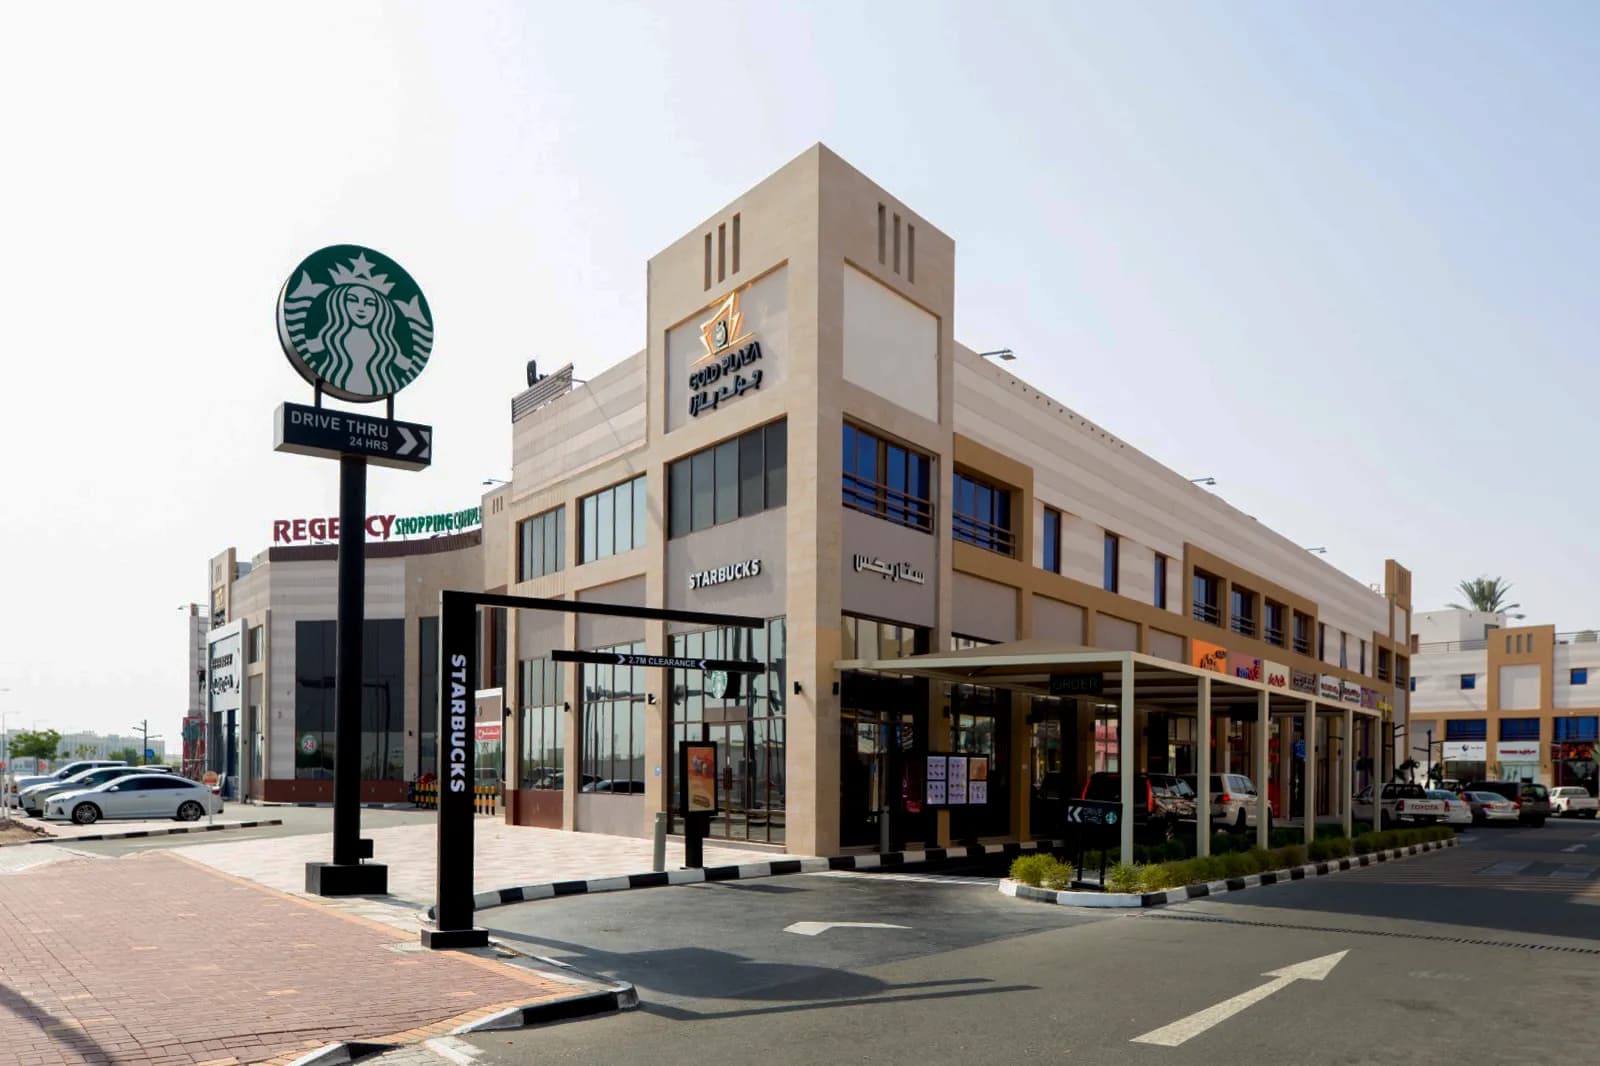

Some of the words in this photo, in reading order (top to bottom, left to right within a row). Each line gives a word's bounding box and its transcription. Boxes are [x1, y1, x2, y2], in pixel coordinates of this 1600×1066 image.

[690, 363, 721, 391] GOLD
[721, 341, 762, 376] PLAZA
[291, 410, 341, 430] DRIVE
[346, 419, 389, 438] THRU
[350, 436, 362, 447] 24
[366, 439, 389, 451] HRS
[273, 515, 396, 544] REGECY
[395, 513, 453, 535] SHOPPING
[689, 559, 762, 590] STARBUCKS
[628, 656, 647, 665] 2.7M
[648, 657, 696, 668] CLEARANCE
[450, 654, 467, 792] STARBUCKS
